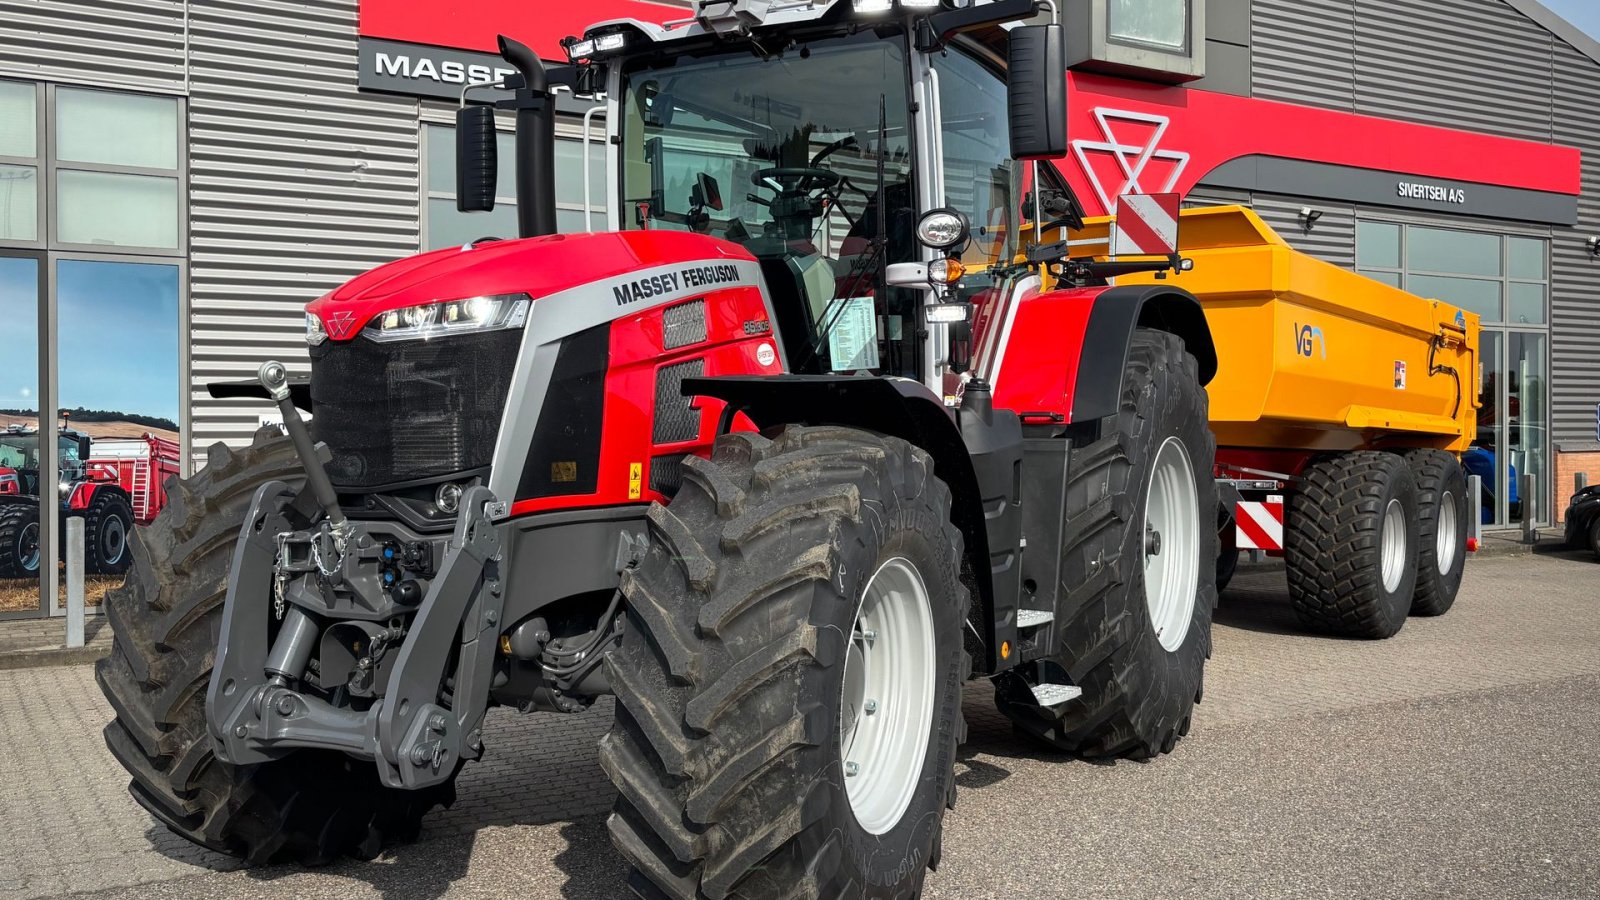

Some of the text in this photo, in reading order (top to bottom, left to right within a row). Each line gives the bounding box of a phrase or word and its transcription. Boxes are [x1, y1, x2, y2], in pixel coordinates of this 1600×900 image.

[375, 53, 520, 89] MASSE
[1398, 182, 1465, 203] SIVERTSEN A/S
[612, 264, 740, 306] MASSEY FERGUSON
